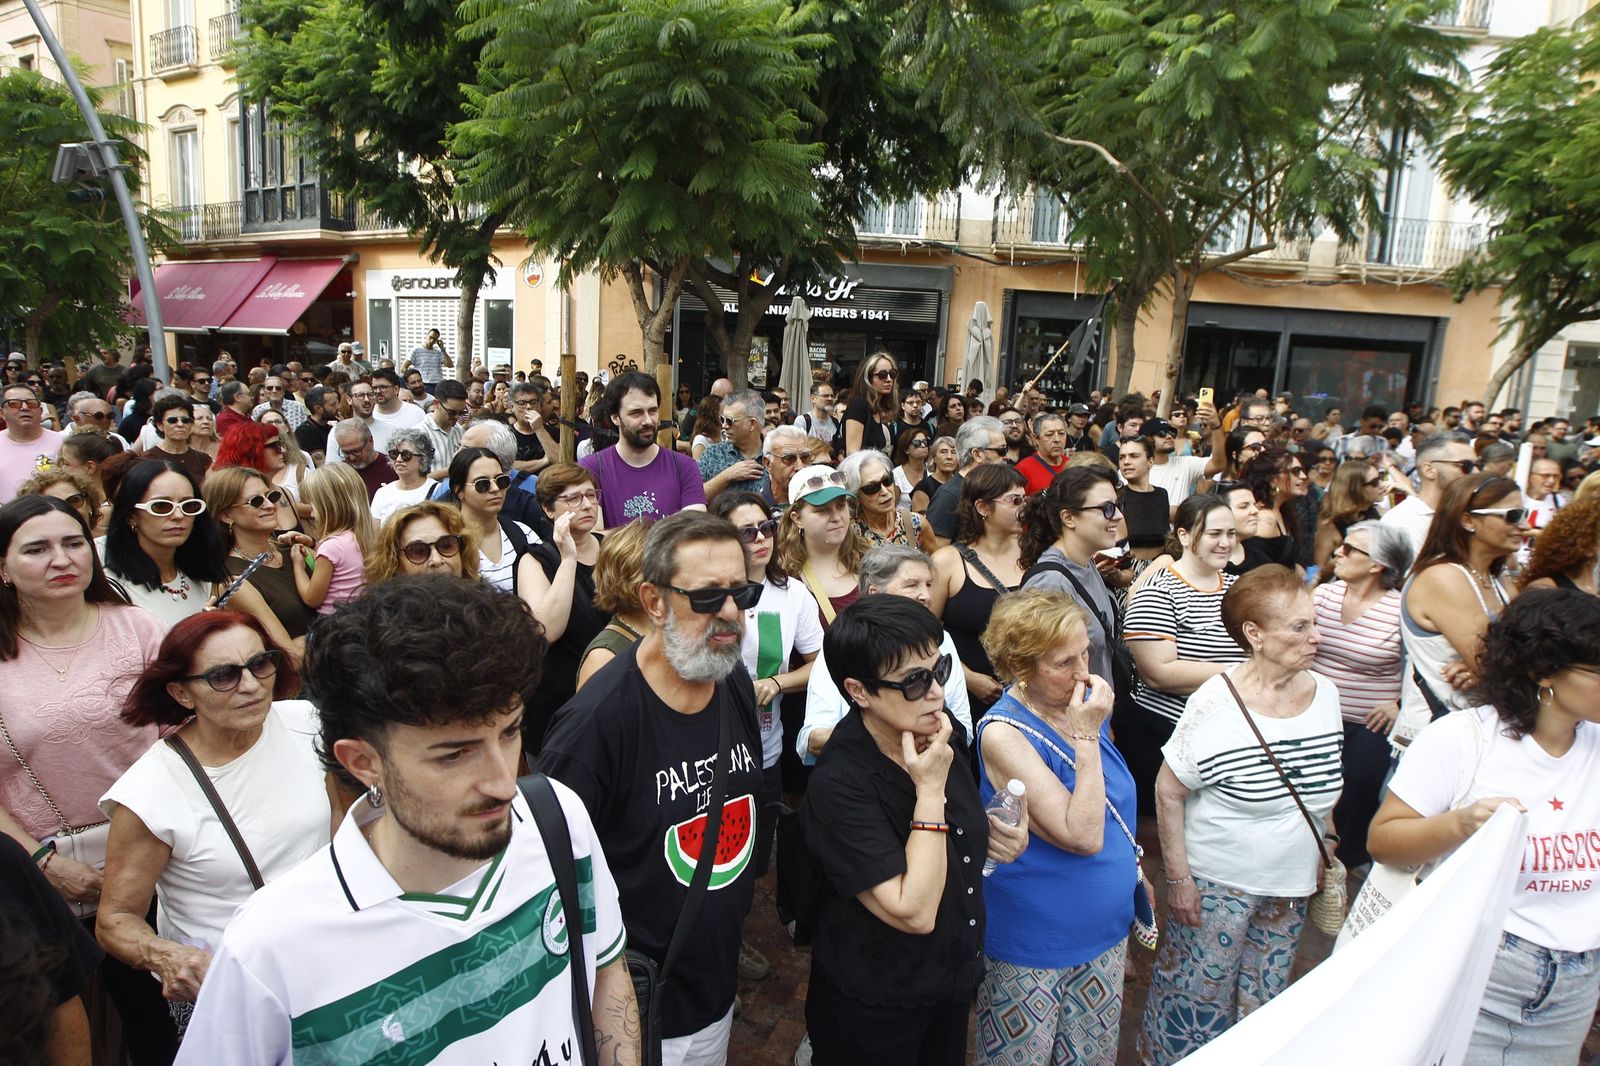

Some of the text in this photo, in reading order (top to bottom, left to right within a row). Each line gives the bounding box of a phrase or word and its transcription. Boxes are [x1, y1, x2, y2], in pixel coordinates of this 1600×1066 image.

[811, 307, 857, 319] RGERS
[861, 309, 889, 321] 1941
[656, 743, 756, 805] PALESNA
[1525, 880, 1592, 893] ATHENS
